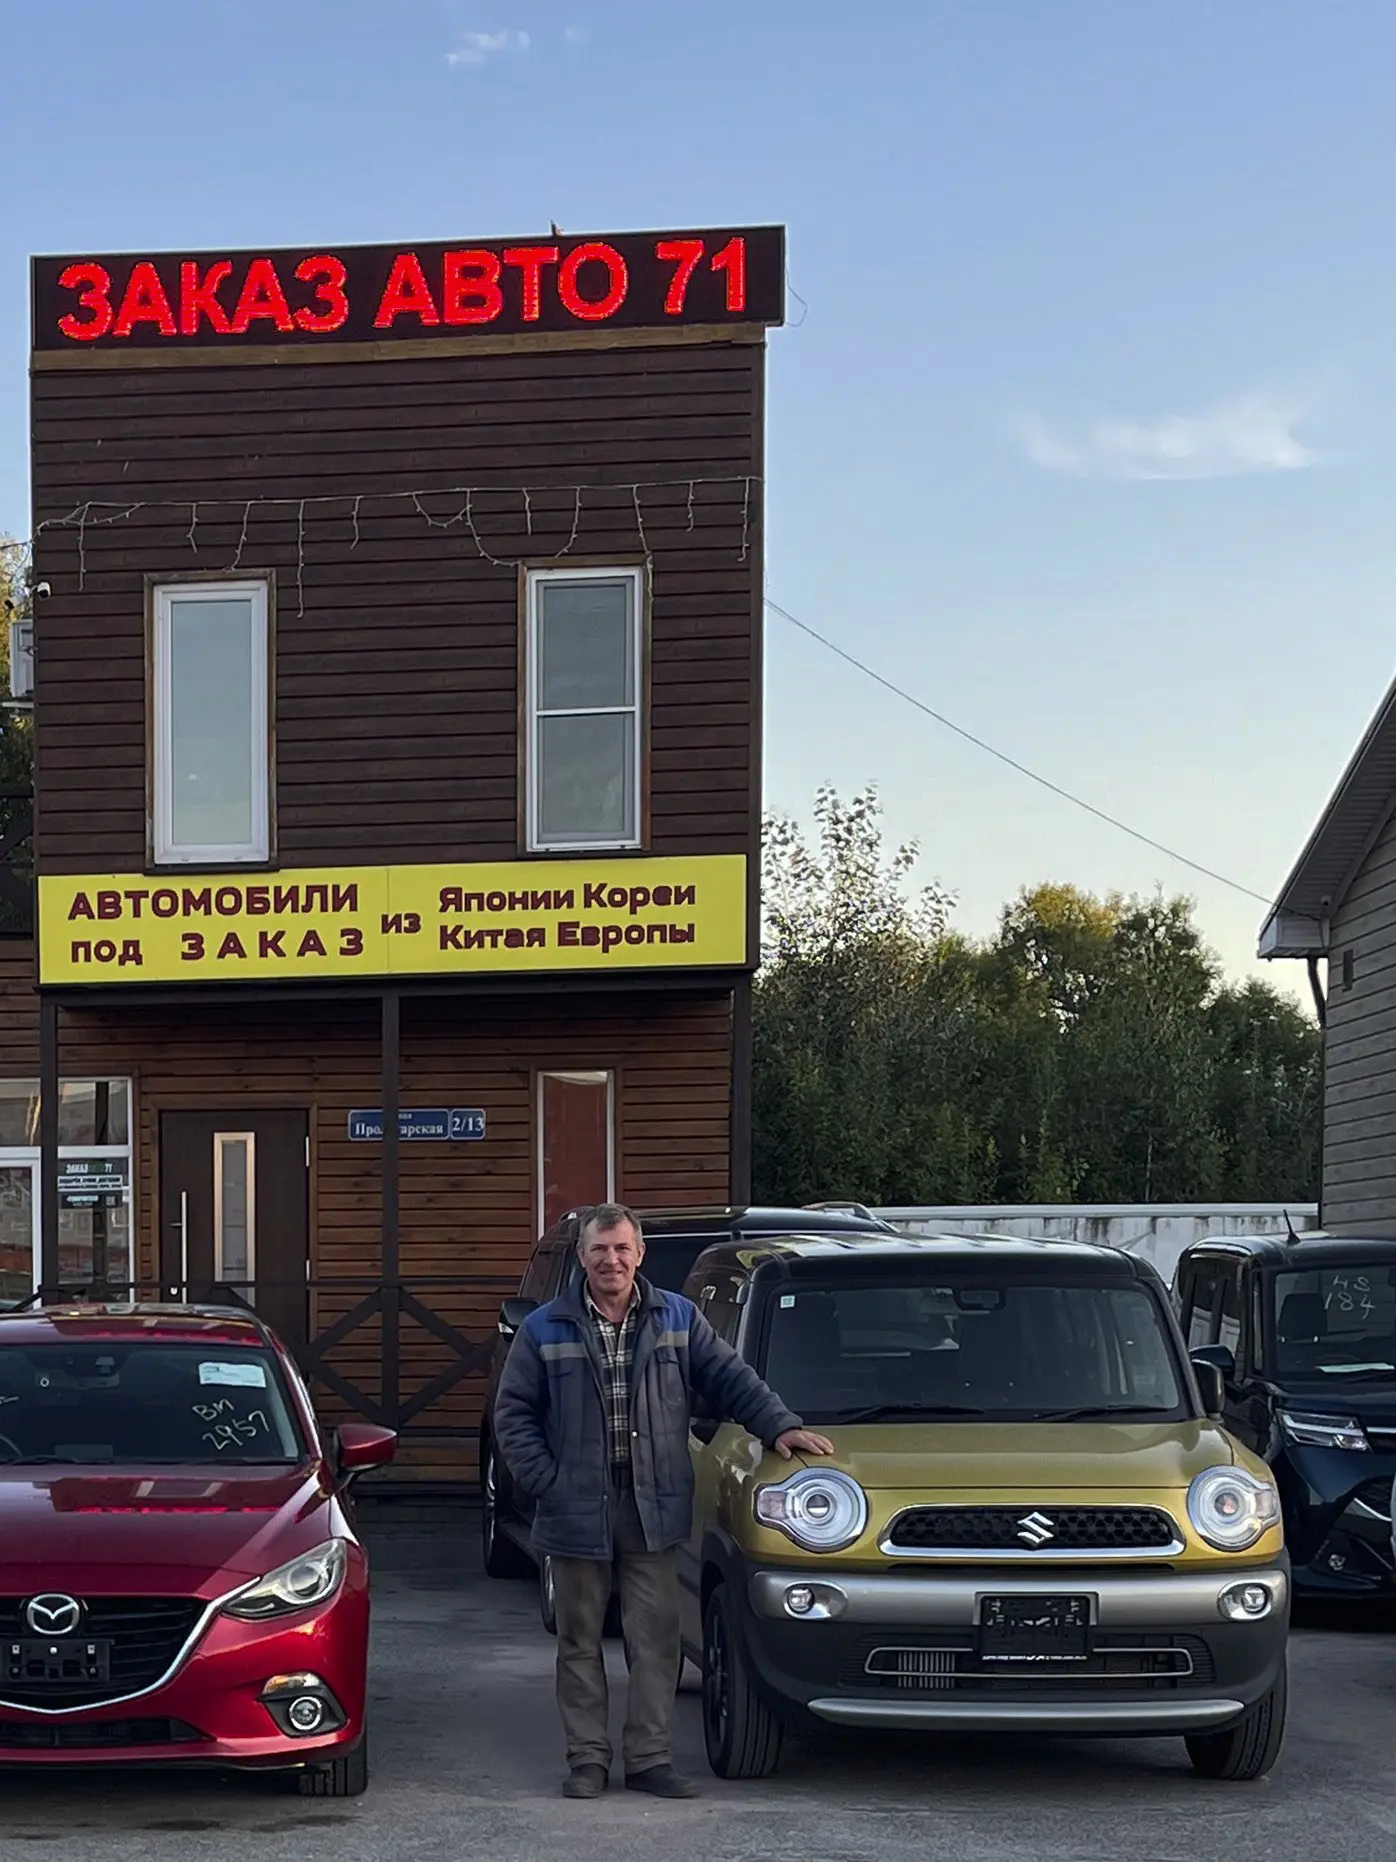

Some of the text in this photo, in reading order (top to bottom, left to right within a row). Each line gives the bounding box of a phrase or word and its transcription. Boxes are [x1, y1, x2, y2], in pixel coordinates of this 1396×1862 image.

[58, 237, 746, 341] ЗАКАЗ АВТО 71
[68, 884, 358, 920] АВТОМОБИЛИ
[438, 882, 696, 915] Японии Кореи
[181, 928, 364, 961] ЗАКАЗ
[439, 921, 695, 953] Китая Европы
[355, 1116, 485, 1137] Проарская 2/13
[1323, 1291, 1377, 1320] 184
[202, 1410, 270, 1450] 2957
